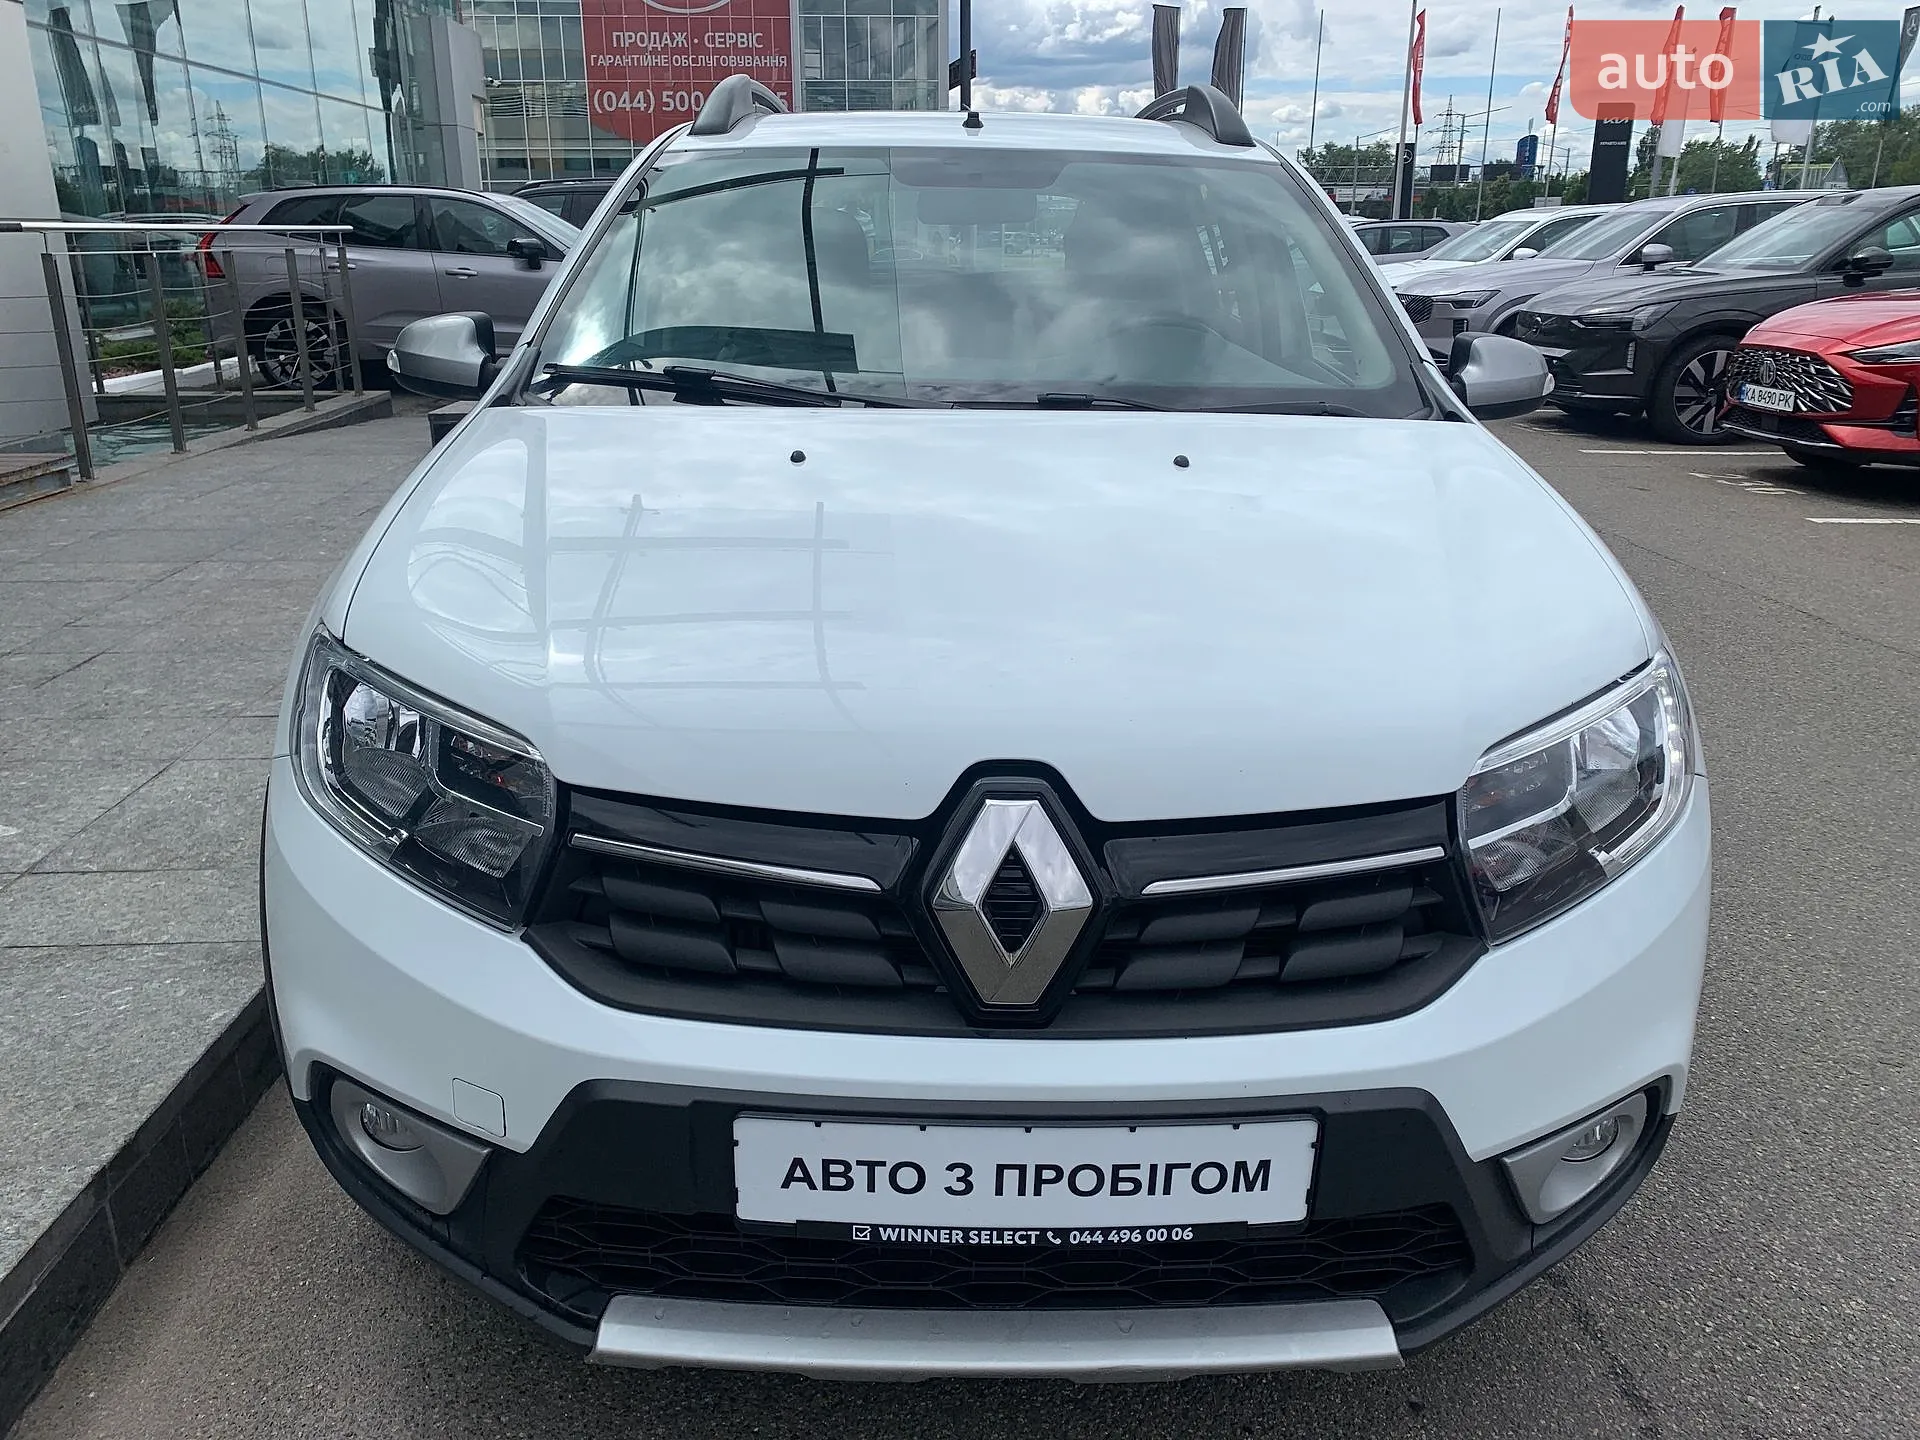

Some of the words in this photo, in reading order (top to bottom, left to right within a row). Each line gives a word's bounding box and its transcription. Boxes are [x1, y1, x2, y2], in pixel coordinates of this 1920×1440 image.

[612, 31, 689, 51] ПРОДАЖ
[704, 32, 764, 48] СЕРВІС
[591, 52, 669, 67] ГАРАНТІЙНЕ
[672, 54, 787, 67] ОБСЛУГОВУВАННЯ
[593, 89, 656, 114] (044)
[1757, 389, 1777, 405] 8490
[780, 1157, 927, 1195] АВТО
[994, 1159, 1272, 1198] ПРОБІГОМ
[879, 1227, 964, 1244] WINNER
[969, 1230, 1040, 1245] SELECT
[1069, 1230, 1105, 1245] 044
[1107, 1229, 1142, 1244] 496
[1145, 1228, 1168, 1242] 00
[1171, 1226, 1194, 1241] 06
